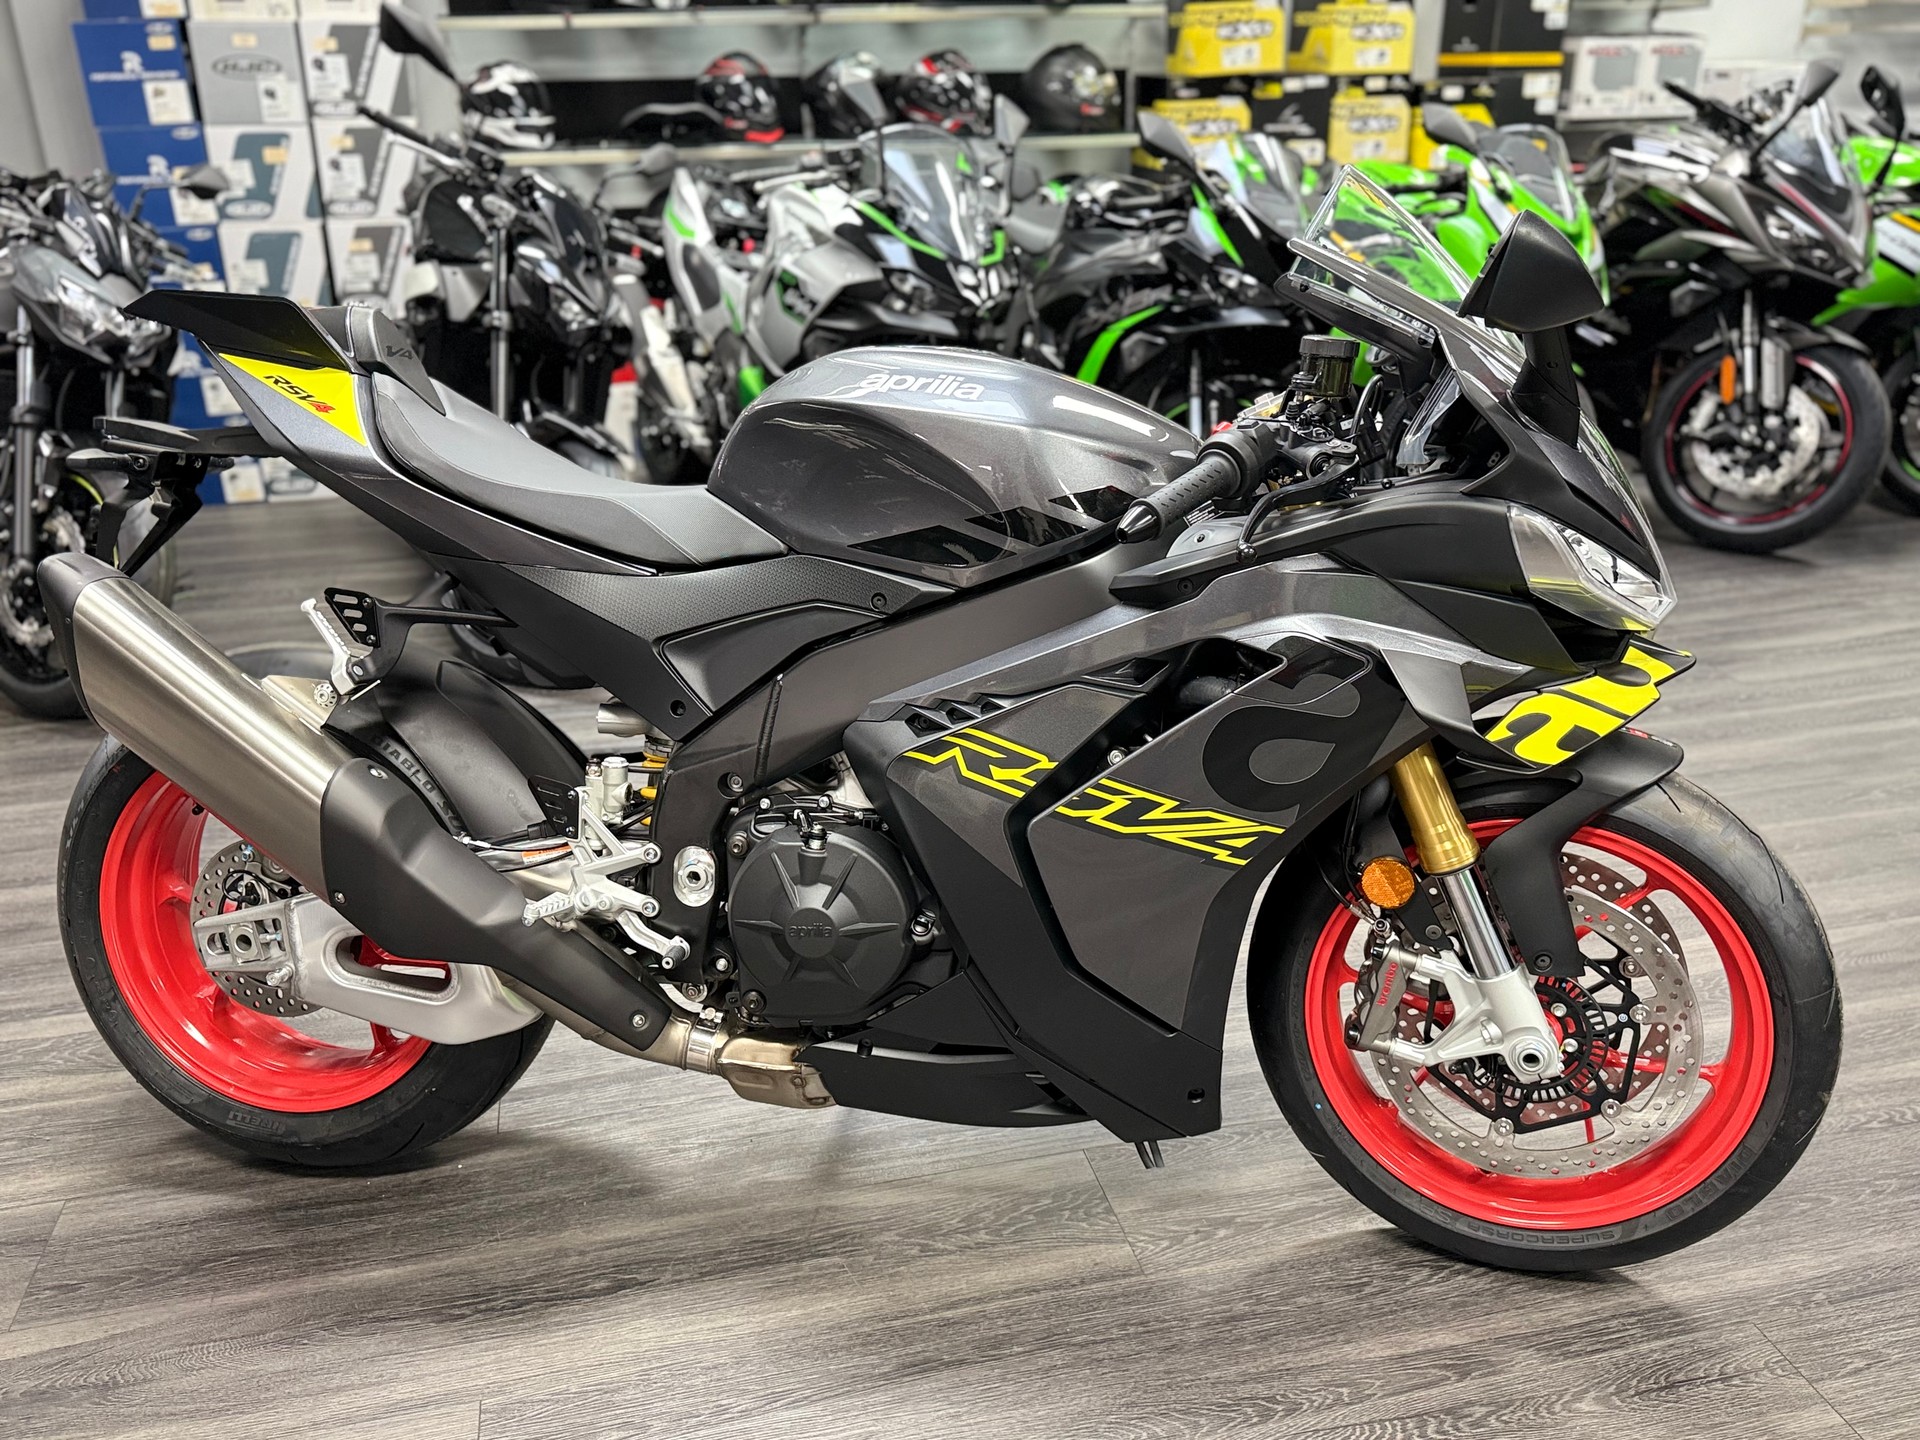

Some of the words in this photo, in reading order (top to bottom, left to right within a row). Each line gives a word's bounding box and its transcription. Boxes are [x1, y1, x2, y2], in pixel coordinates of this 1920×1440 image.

[386, 346, 413, 360] V4
[263, 374, 336, 414] RSV4
[859, 373, 986, 400] aprilia
[903, 727, 1286, 866] RSV4
[788, 922, 833, 938] aprilia
[1376, 961, 1398, 1007] brembo
[1466, 1222, 1616, 1245] SUPERCORSA
